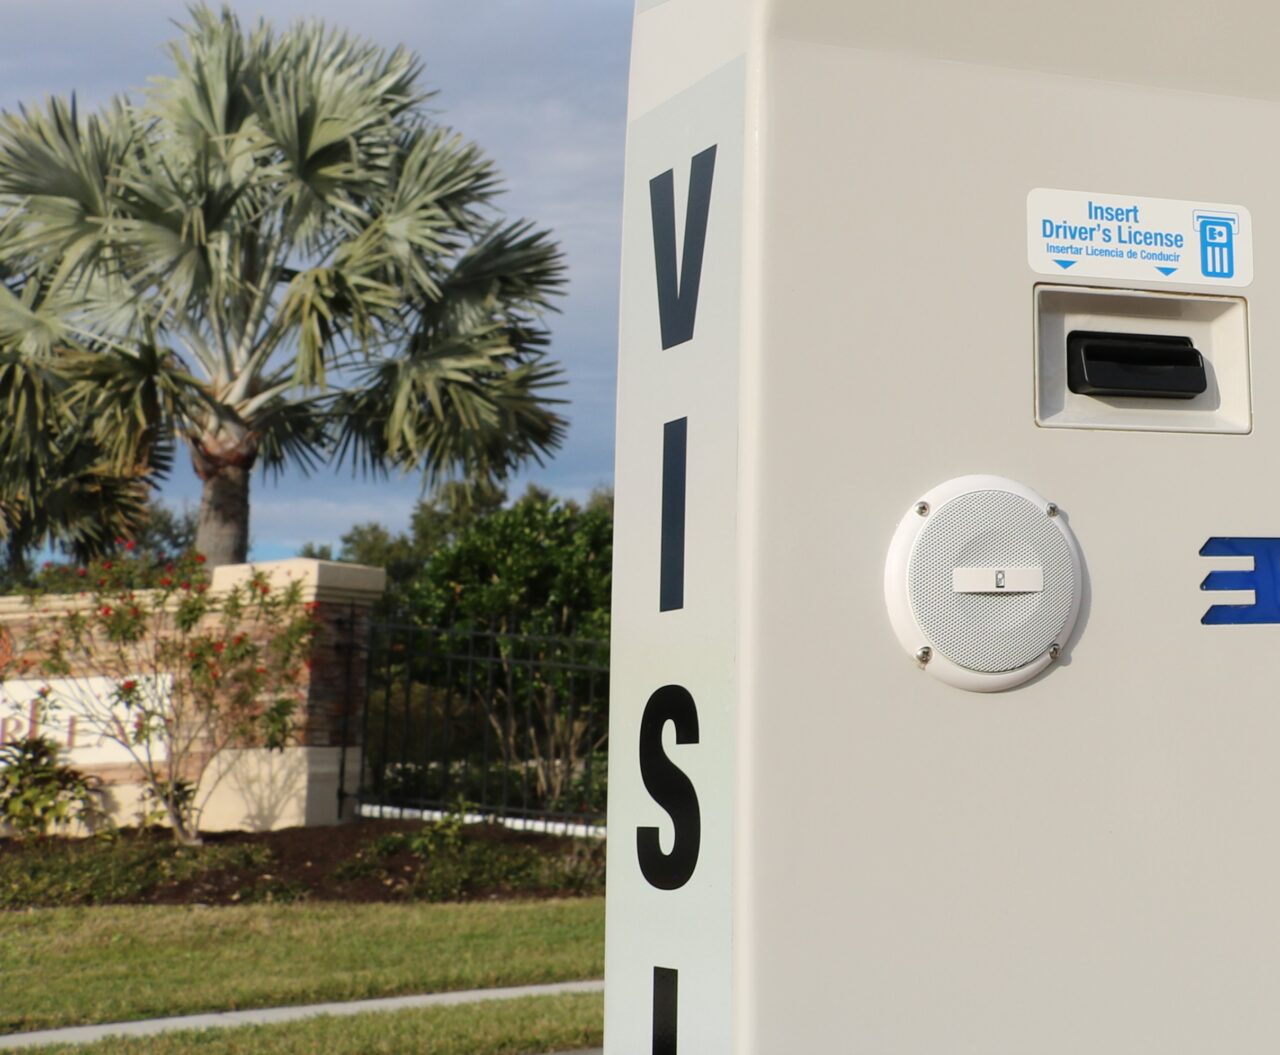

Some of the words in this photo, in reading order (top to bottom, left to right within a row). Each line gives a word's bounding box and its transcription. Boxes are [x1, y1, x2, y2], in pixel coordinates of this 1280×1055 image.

[1087, 201, 1140, 224] Insert
[1042, 219, 1113, 243] Driver's
[1117, 225, 1184, 248] License
[1046, 243, 1083, 256] Insertar
[1085, 246, 1124, 259] Licencia
[1126, 251, 1138, 260] de
[1140, 250, 1181, 263] Conducir
